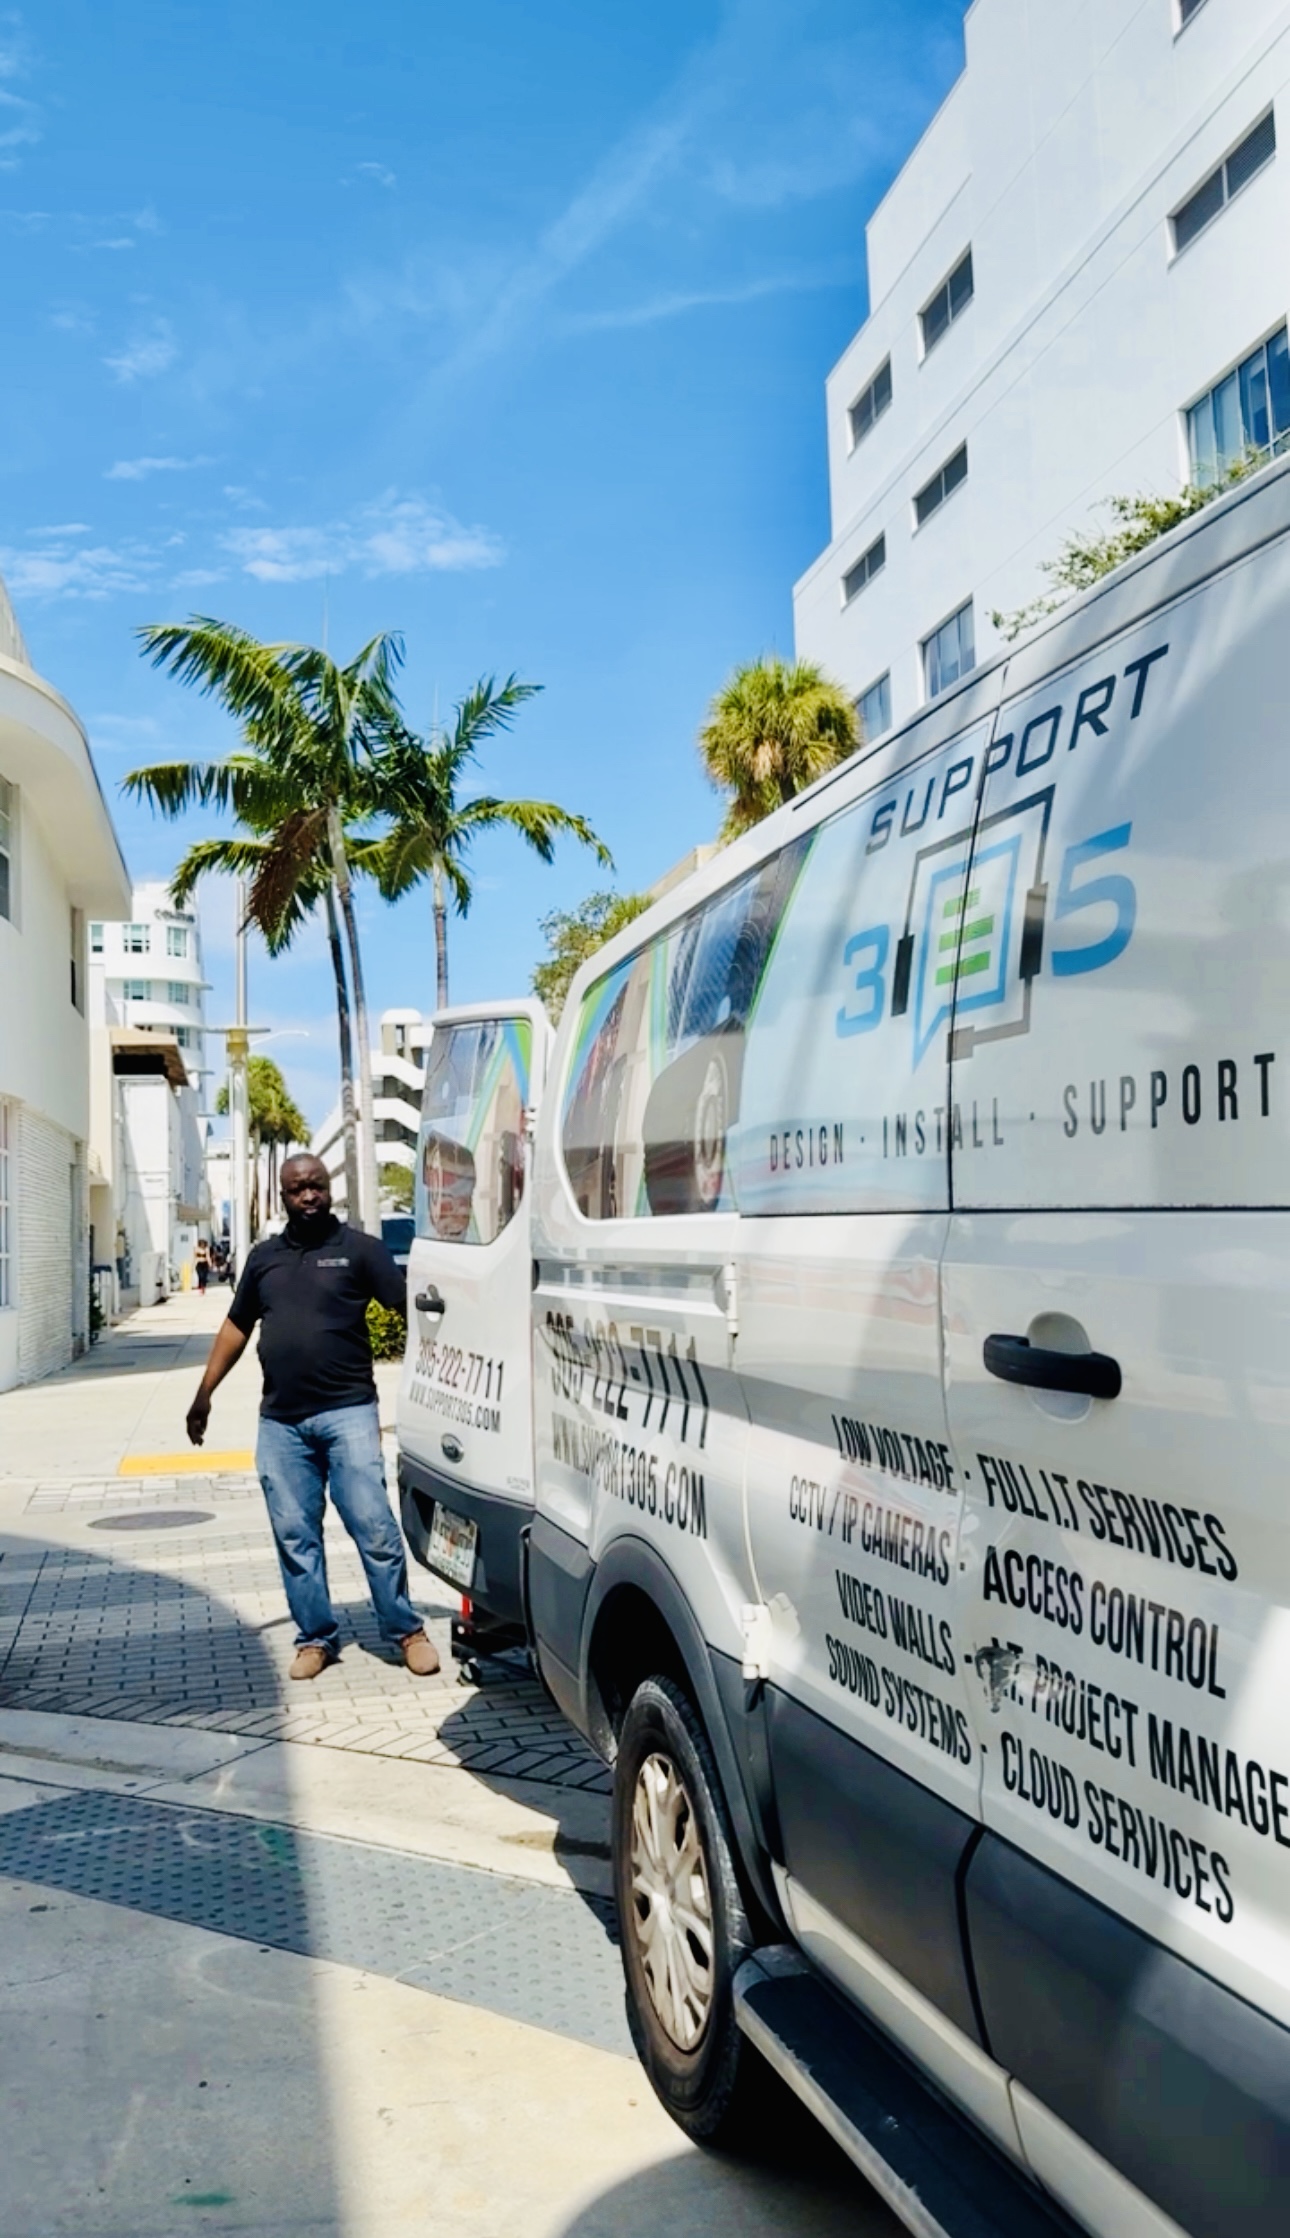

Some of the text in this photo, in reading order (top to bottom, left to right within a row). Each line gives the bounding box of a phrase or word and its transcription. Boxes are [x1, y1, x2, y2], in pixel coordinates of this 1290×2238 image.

[865, 643, 1169, 856] SUPPORT
[769, 1052, 1276, 1172] DESIGN INSTALL SUPPORT
[414, 1336, 504, 1402] 305-222-7711
[789, 1475, 827, 1531] CCTV
[842, 1494, 859, 1544] IP
[861, 1502, 951, 1596] CAMERAS
[983, 1545, 1084, 1636] ACCESS
[1090, 1580, 1227, 1699] CONTROL
[831, 1413, 872, 1468] LOW
[868, 1423, 958, 1497] VOLTAGE
[976, 1453, 1049, 1522] FULL
[1076, 1479, 1239, 1582] SERVICES
[825, 1633, 1235, 1924] SOUND SYSTEMS CLOUD SERVICES
[835, 1569, 887, 1639] VIDEO
[888, 1595, 956, 1676] WALLS
[1031, 1653, 1139, 1768] PROJECT
[1148, 1712, 1290, 1849] MANAGE
